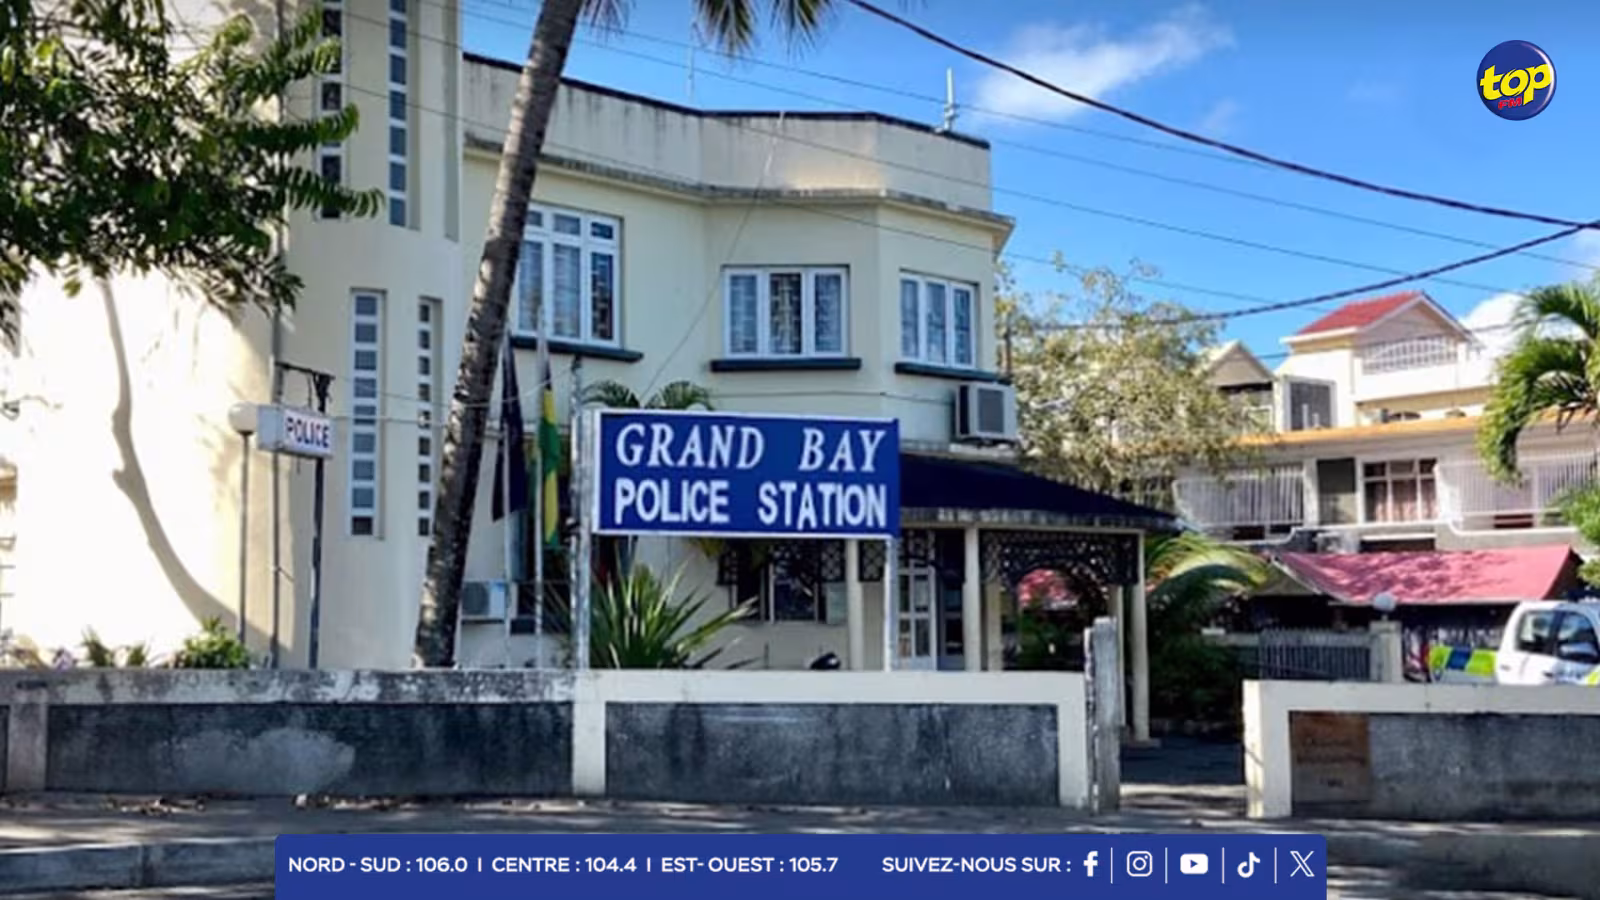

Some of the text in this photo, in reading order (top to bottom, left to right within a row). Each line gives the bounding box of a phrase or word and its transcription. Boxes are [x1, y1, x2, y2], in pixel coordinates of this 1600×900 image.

[286, 417, 329, 448] POLICE
[616, 423, 886, 472] GRAND BAY
[614, 477, 887, 530] POLICE STATION
